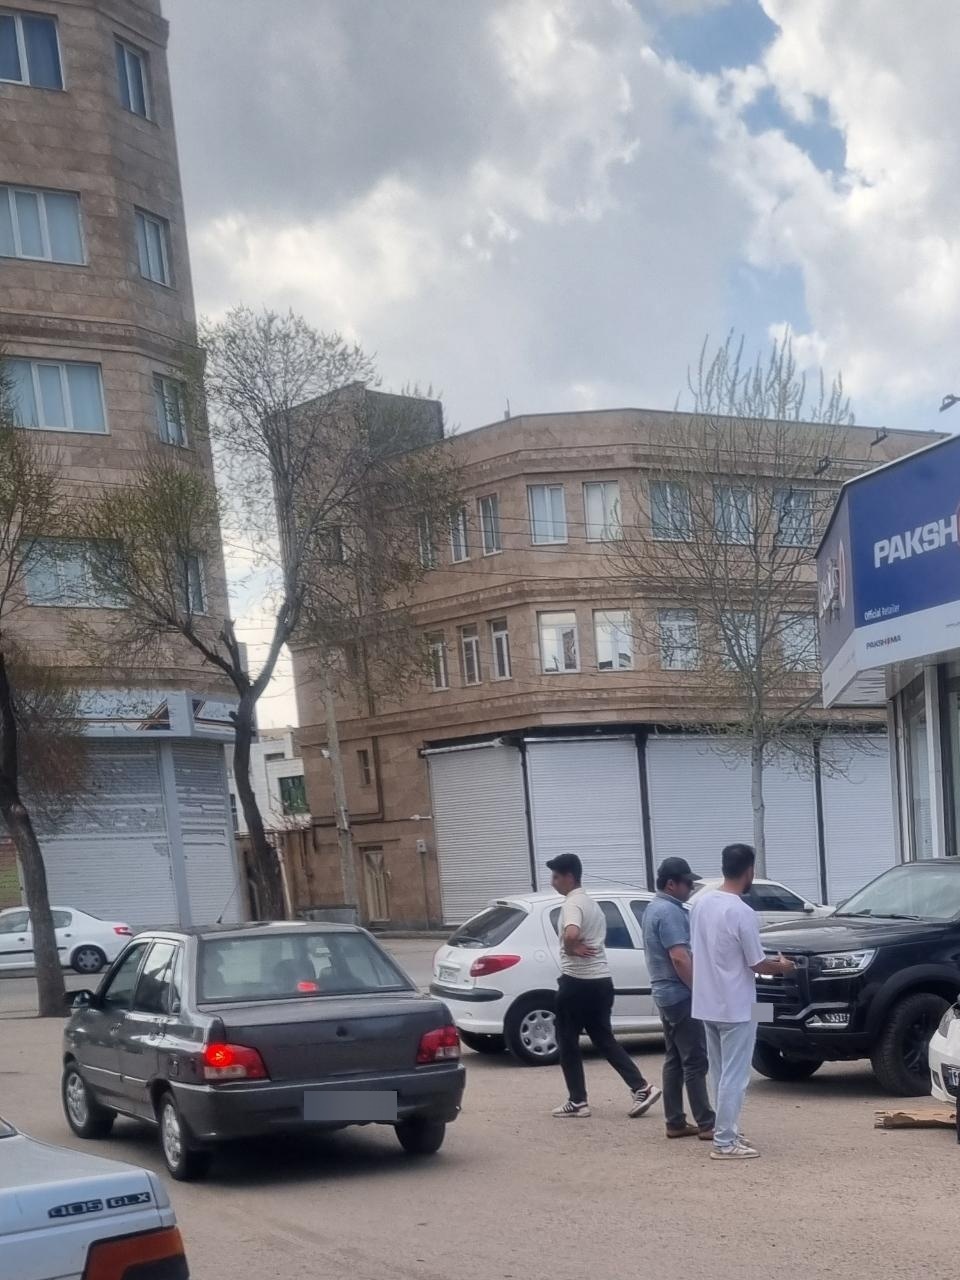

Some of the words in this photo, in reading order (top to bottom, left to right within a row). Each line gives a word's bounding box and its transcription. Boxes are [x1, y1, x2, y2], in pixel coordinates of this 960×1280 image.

[864, 608, 881, 621] Official
[881, 603, 900, 616] Retailer
[866, 635, 902, 650] PAKSHOMA
[50, 1199, 103, 1217] 405
[110, 1193, 149, 1208] GLX
